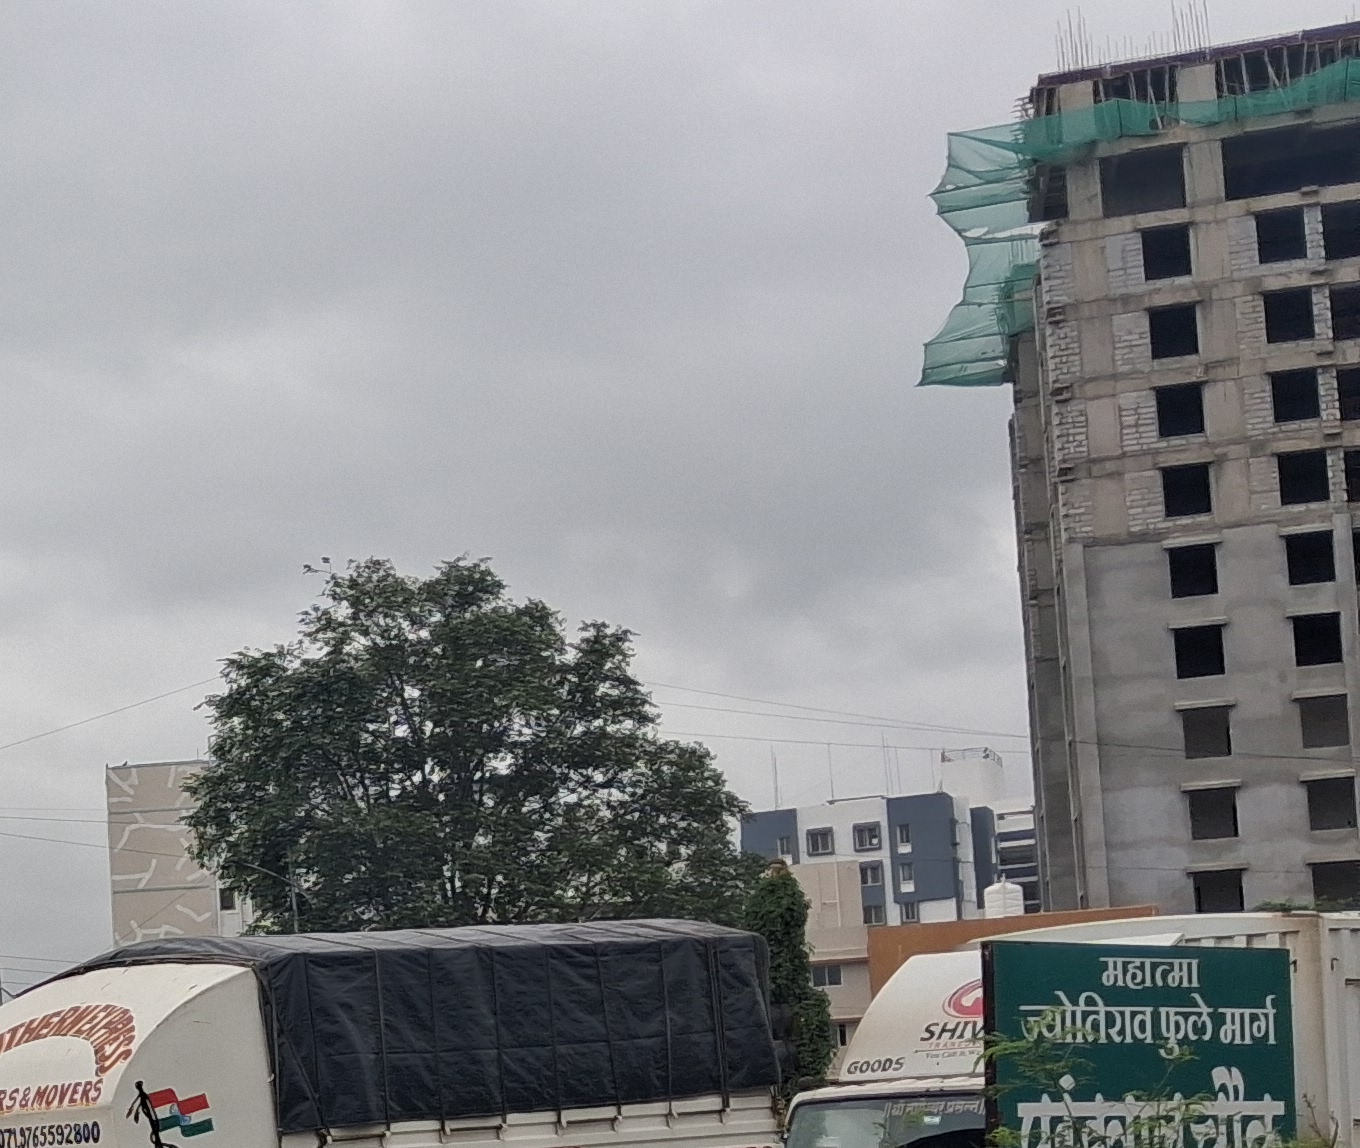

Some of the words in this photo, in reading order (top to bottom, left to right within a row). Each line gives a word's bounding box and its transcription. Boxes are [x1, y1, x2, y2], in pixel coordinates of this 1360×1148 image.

[1098, 957, 1201, 989] महात्मा
[1018, 990, 1154, 1043] ज्योतिराव
[1159, 993, 1214, 1059] फुले
[1218, 994, 1278, 1045] मार्ग
[847, 1056, 906, 1075] GOODS
